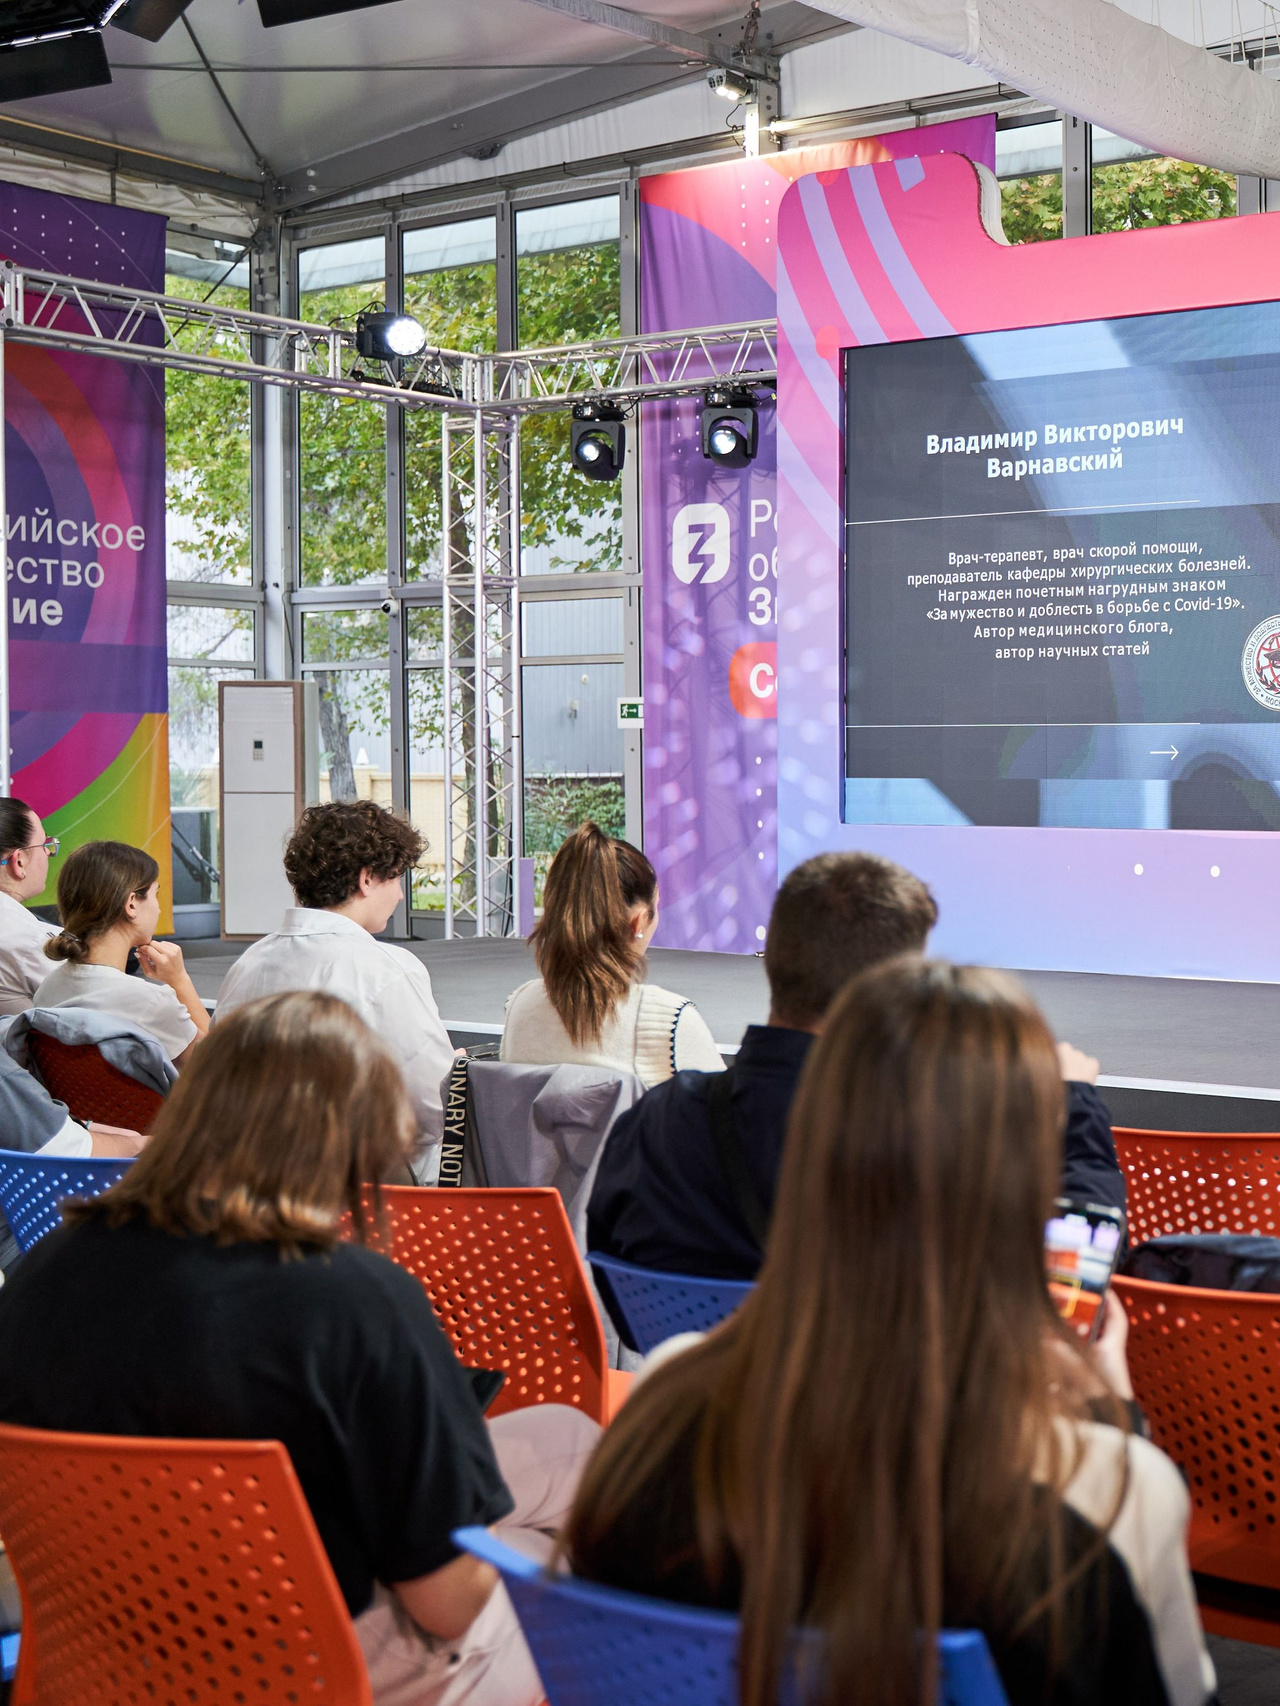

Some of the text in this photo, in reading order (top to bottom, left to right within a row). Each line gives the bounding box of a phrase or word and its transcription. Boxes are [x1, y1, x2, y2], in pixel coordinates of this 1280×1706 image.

[926, 417, 1184, 455] Владимир Викторович
[987, 446, 1123, 480] Варнавский
[750, 499, 778, 537] Р
[948, 540, 1203, 568] Врач-терапевт, врач скорой помощи,
[907, 554, 1251, 589] преподаватель кафедры хирургических болезней.
[938, 579, 1226, 605] Награжден почетным нагрудным знаком
[926, 595, 1245, 623] «За мужество и доблесть в борьбе с Covid-19».
[973, 619, 1174, 641] Автор медицинского блога,
[994, 640, 1150, 662] автор научных статей
[439, 1056, 469, 1187] DINARY NOT
